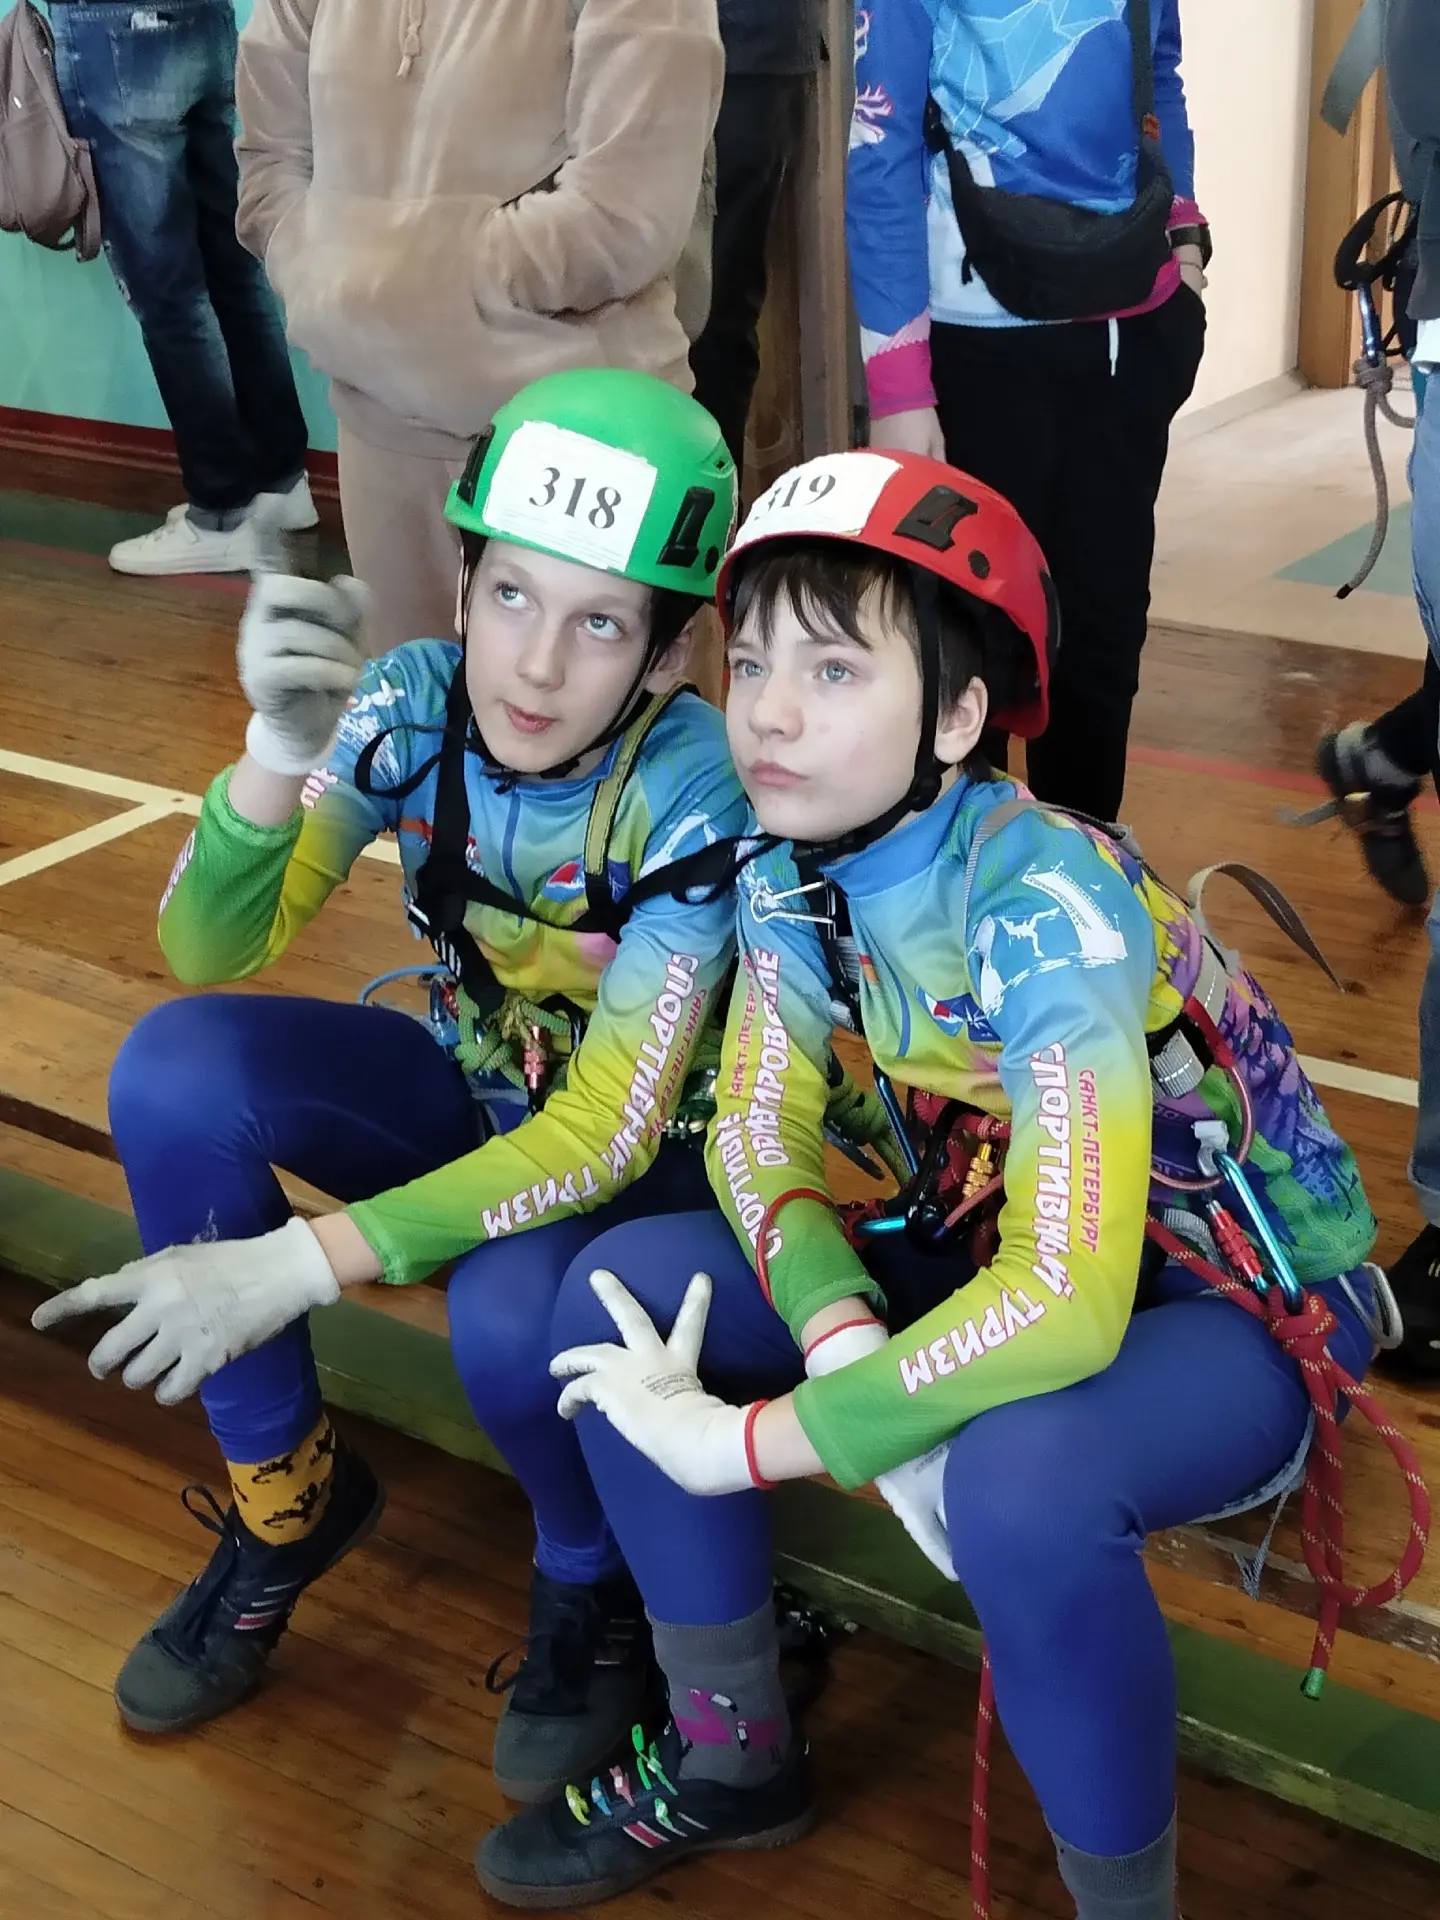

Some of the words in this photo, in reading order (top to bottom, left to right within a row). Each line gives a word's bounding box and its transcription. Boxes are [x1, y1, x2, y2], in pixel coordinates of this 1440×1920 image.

[529, 466, 622, 529] 318
[1028, 1041, 1075, 1302] СПОРТИВНЫЙ
[1077, 1068, 1101, 1254] САНКТ-ПЕТЕРБУРГ
[898, 1287, 1048, 1396] ТУРИЗМ
